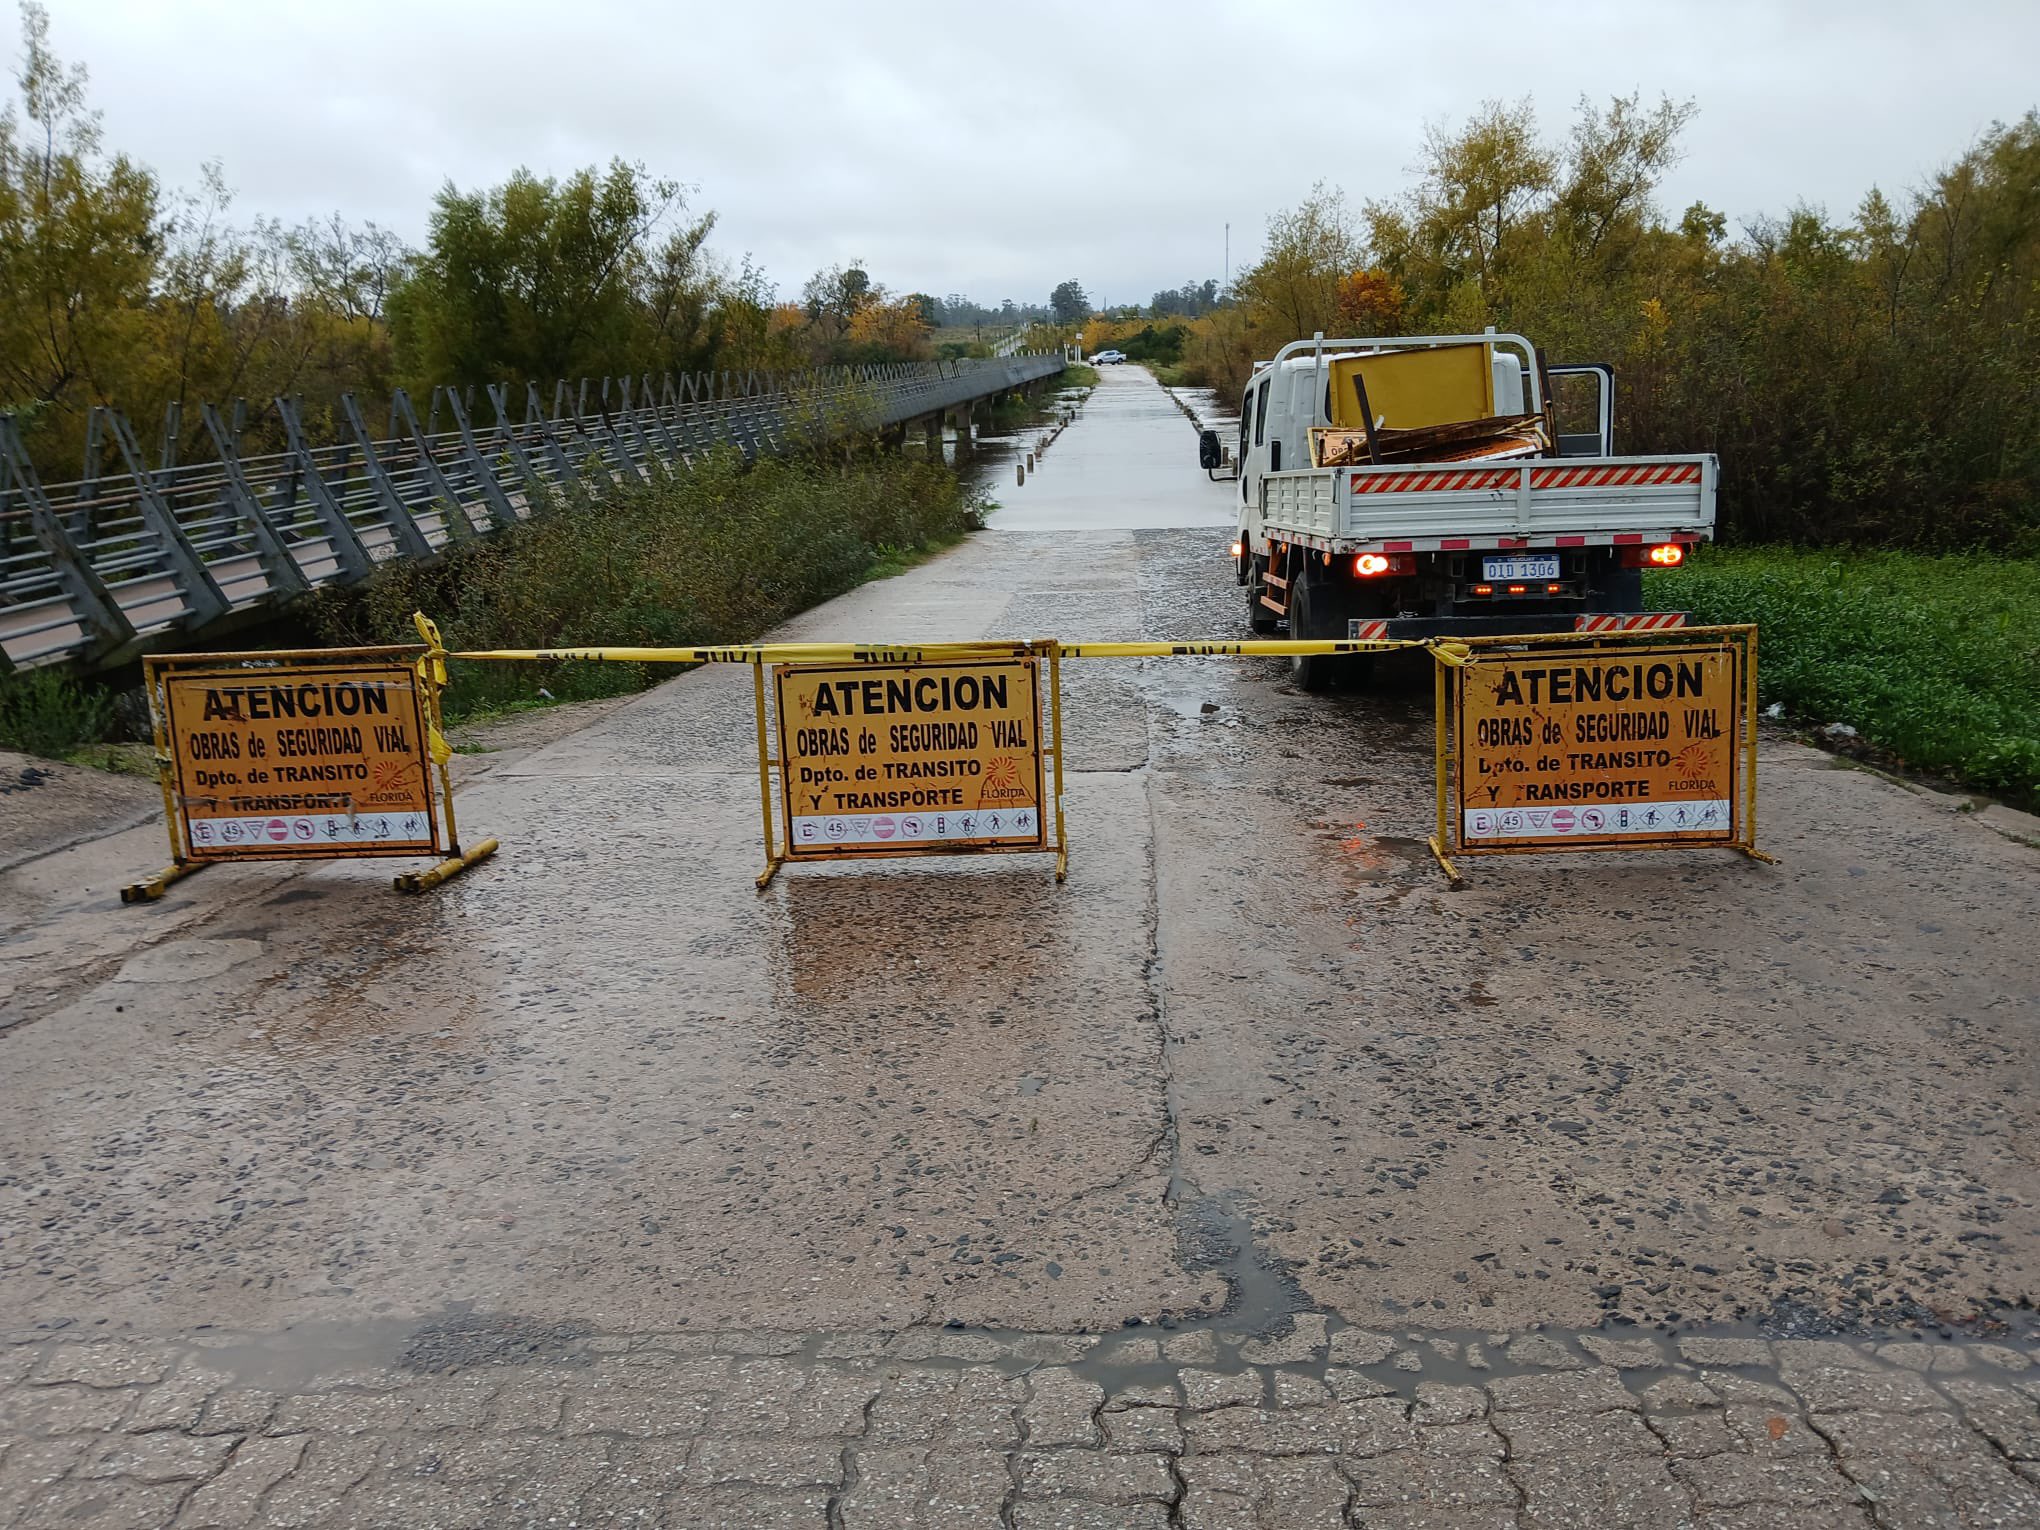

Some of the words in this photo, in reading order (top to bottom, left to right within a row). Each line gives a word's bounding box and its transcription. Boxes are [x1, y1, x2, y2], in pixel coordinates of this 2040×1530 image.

[1521, 563, 1554, 576] 1306
[1496, 662, 1703, 706] ATENCION
[203, 681, 388, 721] ATENCION
[813, 675, 1008, 717] ATENCION
[797, 727, 850, 757] OBRAS
[859, 727, 877, 754] de
[890, 721, 978, 753] SEGURIDAD
[991, 719, 1027, 749] VIAL
[1478, 717, 1533, 747] OBRAS
[1542, 717, 1561, 744] de
[1575, 711, 1670, 743] SEGURIDAD
[1684, 709, 1721, 738] VIAL
[190, 731, 240, 761] OBRAS
[249, 733, 266, 758] de
[277, 725, 363, 757] SEGURIDAD
[374, 724, 411, 753] VIAL
[1537, 755, 1560, 771] de
[1567, 749, 1671, 773] TRANSITO
[196, 769, 242, 788] Dpto.
[249, 768, 269, 784] de
[274, 763, 368, 783] TRANSITO
[800, 766, 848, 787] Dpto.
[855, 764, 877, 781] de
[883, 759, 981, 779] TRANSITO
[370, 791, 413, 802] FLORIDA
[980, 788, 1025, 799] FLORIDA
[1487, 786, 1500, 801] Y
[1668, 780, 1716, 790] FLORIDA
[201, 795, 218, 812] Y
[229, 792, 352, 812] TRANSPORTE
[809, 794, 823, 810] Y
[834, 788, 963, 809] TRANSPORTE
[828, 824, 842, 832] 45
[1503, 816, 1518, 825] 45
